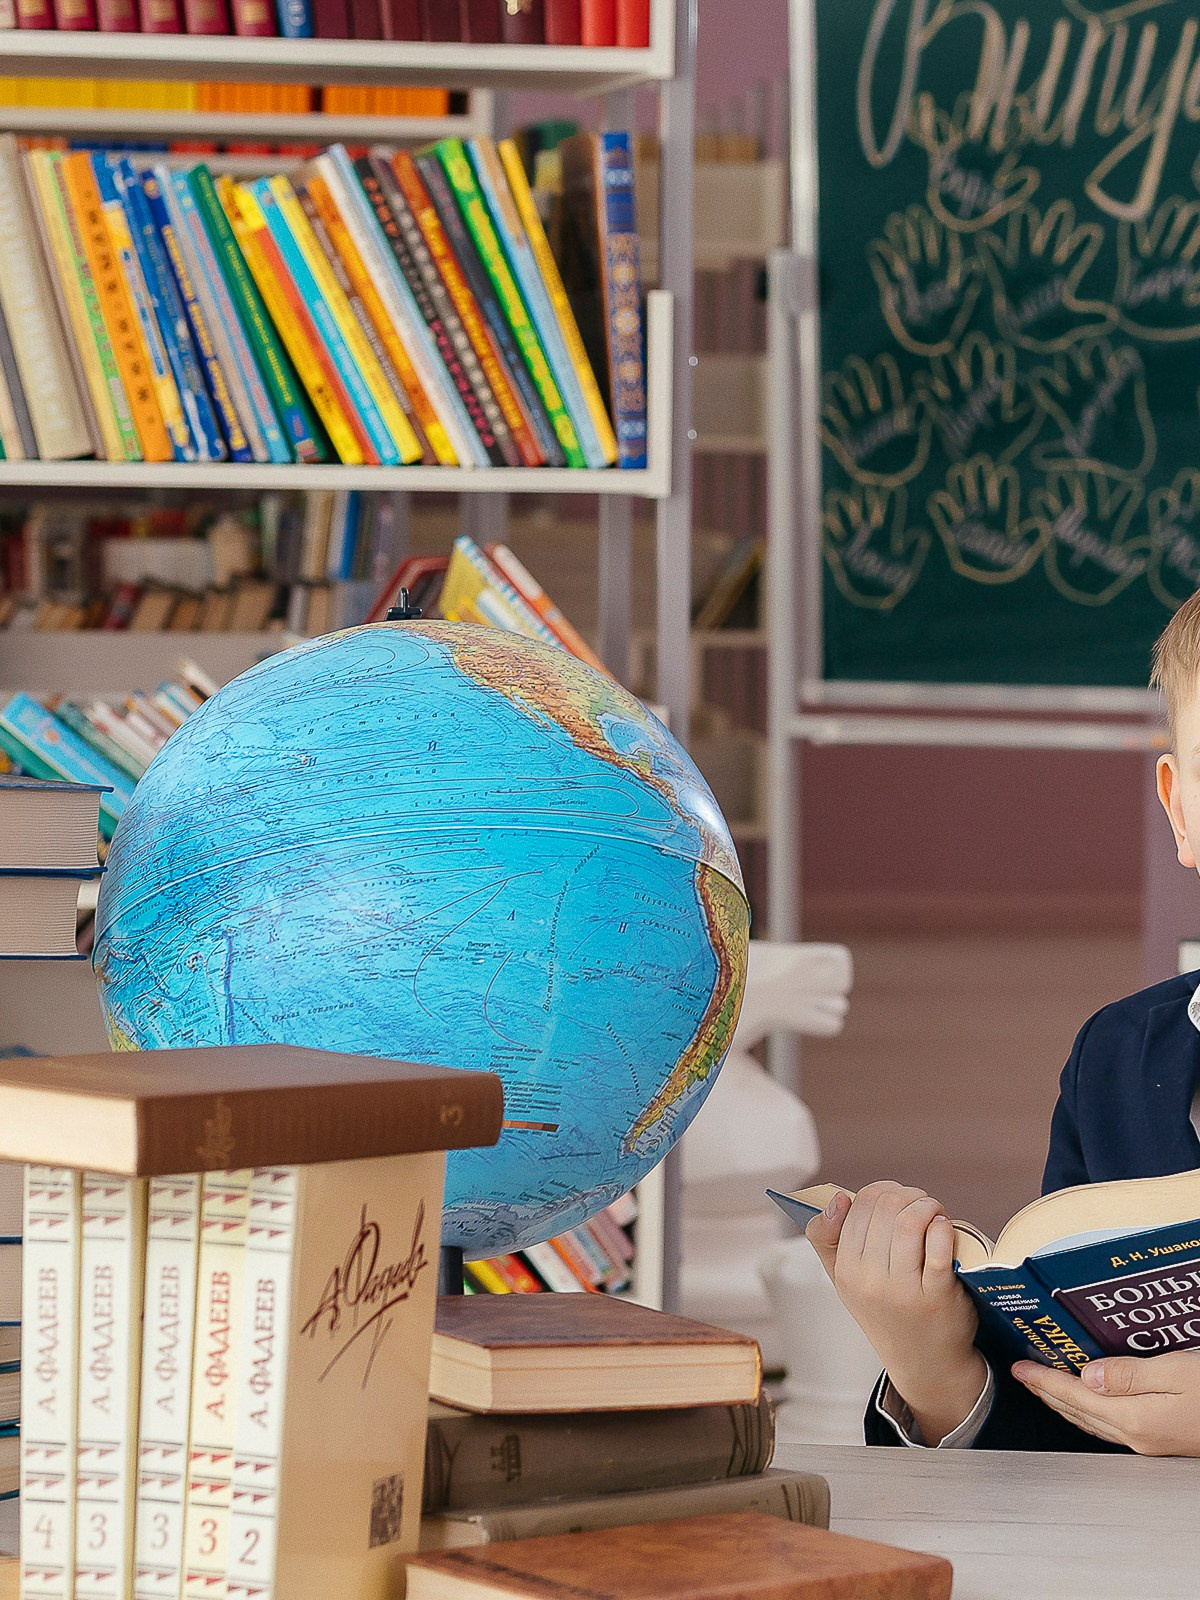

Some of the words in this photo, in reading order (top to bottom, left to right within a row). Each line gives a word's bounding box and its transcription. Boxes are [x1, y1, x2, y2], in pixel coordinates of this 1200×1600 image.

[1110, 1255, 1129, 1267] Д.
[1132, 1251, 1148, 1262] Н.
[35, 1266, 59, 1382] ФАДЕЕВ
[89, 1265, 114, 1381] ФАДЕЕВ
[154, 1265, 180, 1382] ФАДЕЕВ
[203, 1270, 232, 1387] ФАДЕЕВ
[248, 1278, 275, 1396] ФАДЕЕВ
[1012, 1317, 1059, 1361] СЛОВАРЬ
[33, 1513, 55, 1549] 4
[89, 1512, 108, 1550] 3
[151, 1512, 170, 1550] 3
[198, 1517, 219, 1556] 3
[238, 1527, 261, 1565] 2
